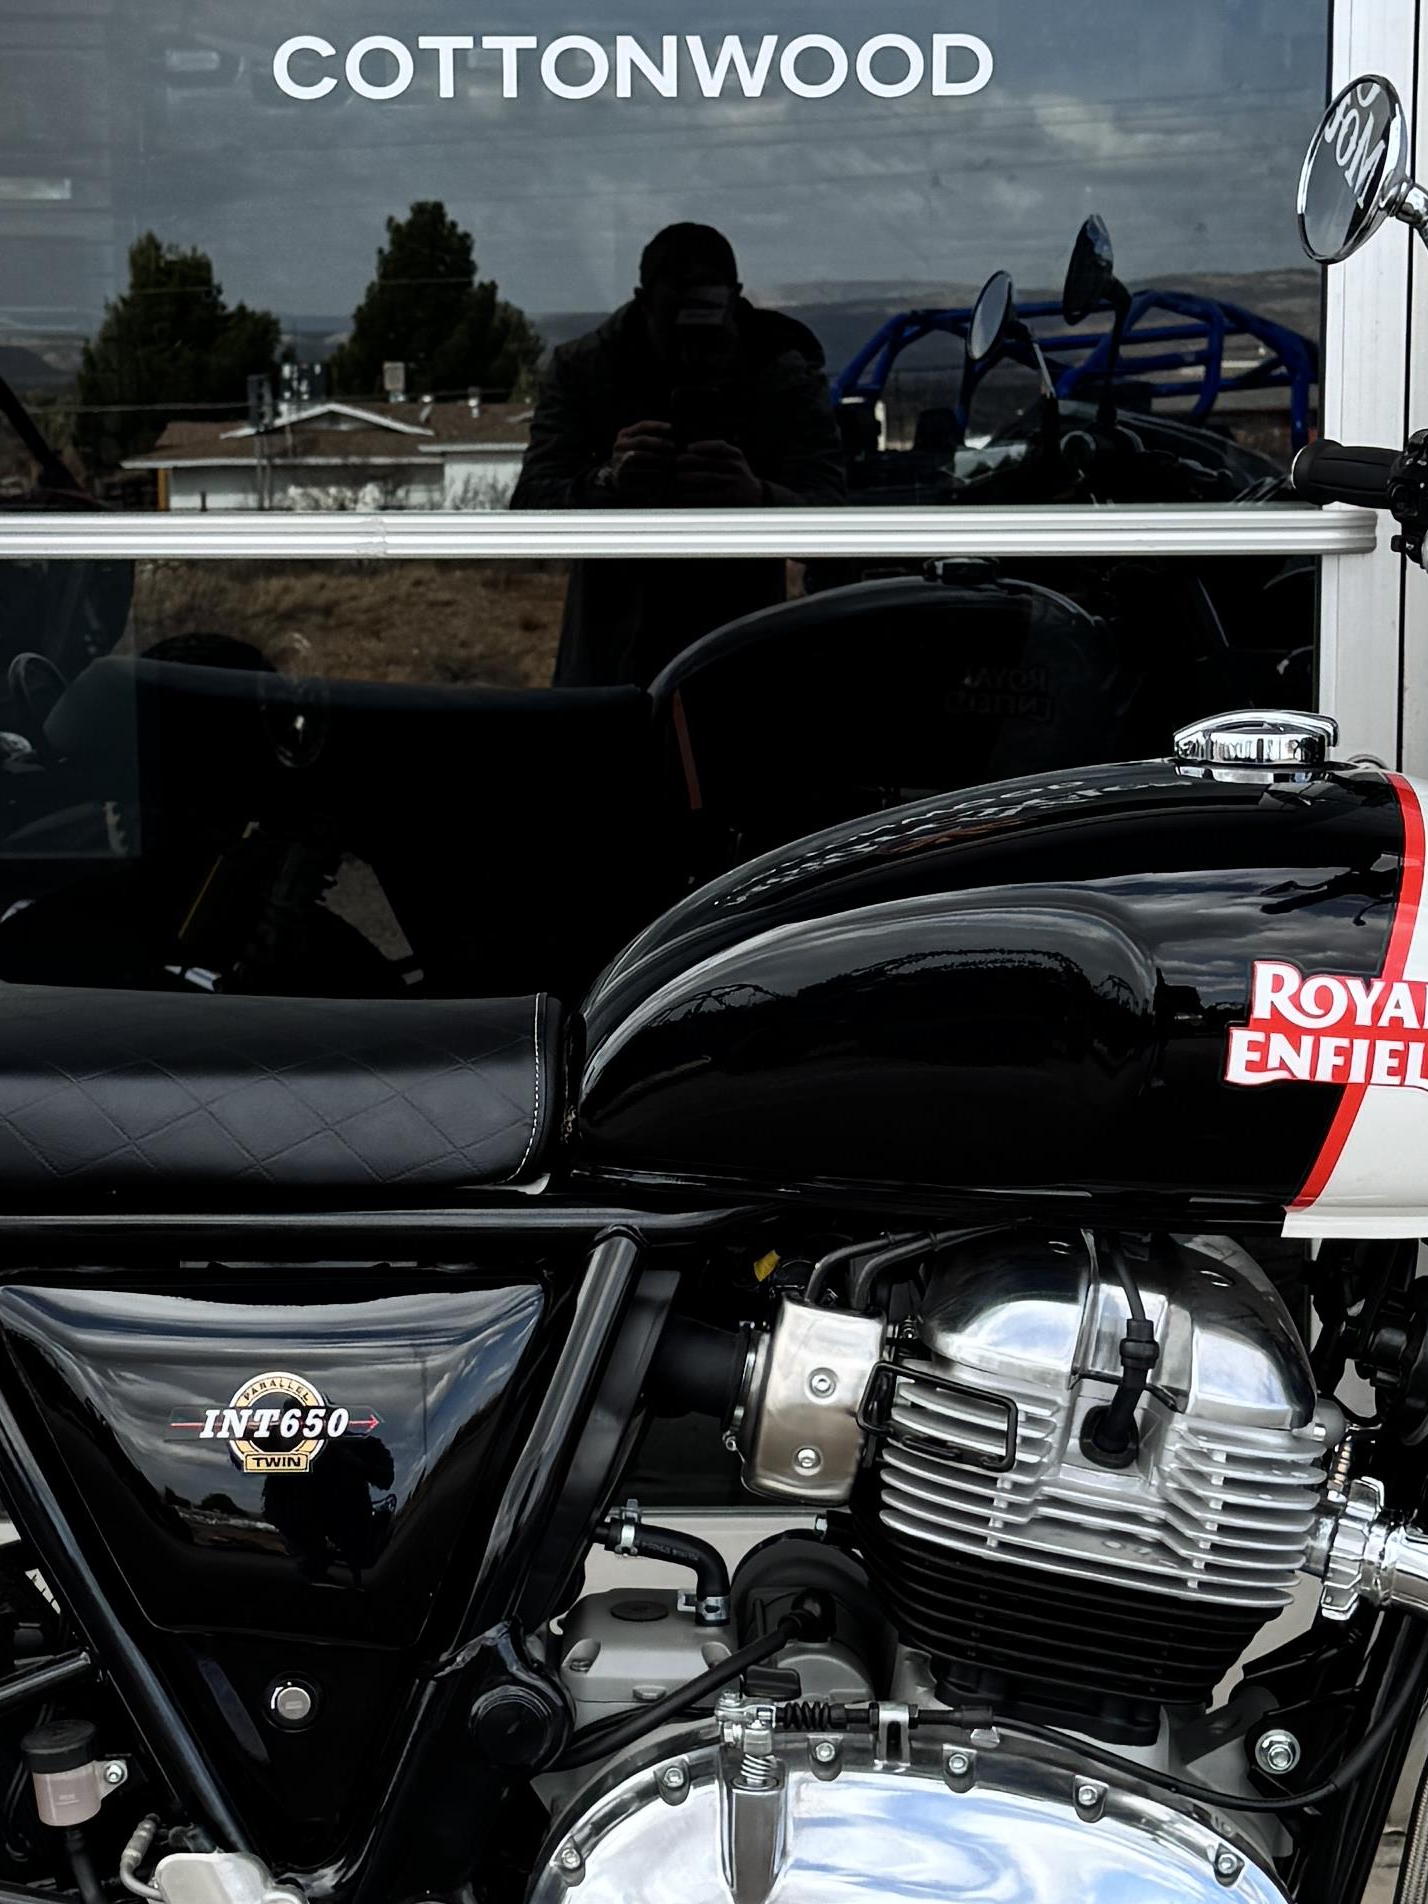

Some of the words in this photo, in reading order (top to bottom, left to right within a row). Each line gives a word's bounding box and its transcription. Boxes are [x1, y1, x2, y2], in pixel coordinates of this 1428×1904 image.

[271, 32, 994, 101] COTTONWOOD
[243, 1379, 310, 1402] PARALLEL
[199, 1407, 349, 1439] INT650
[251, 1456, 301, 1468] TWIN
